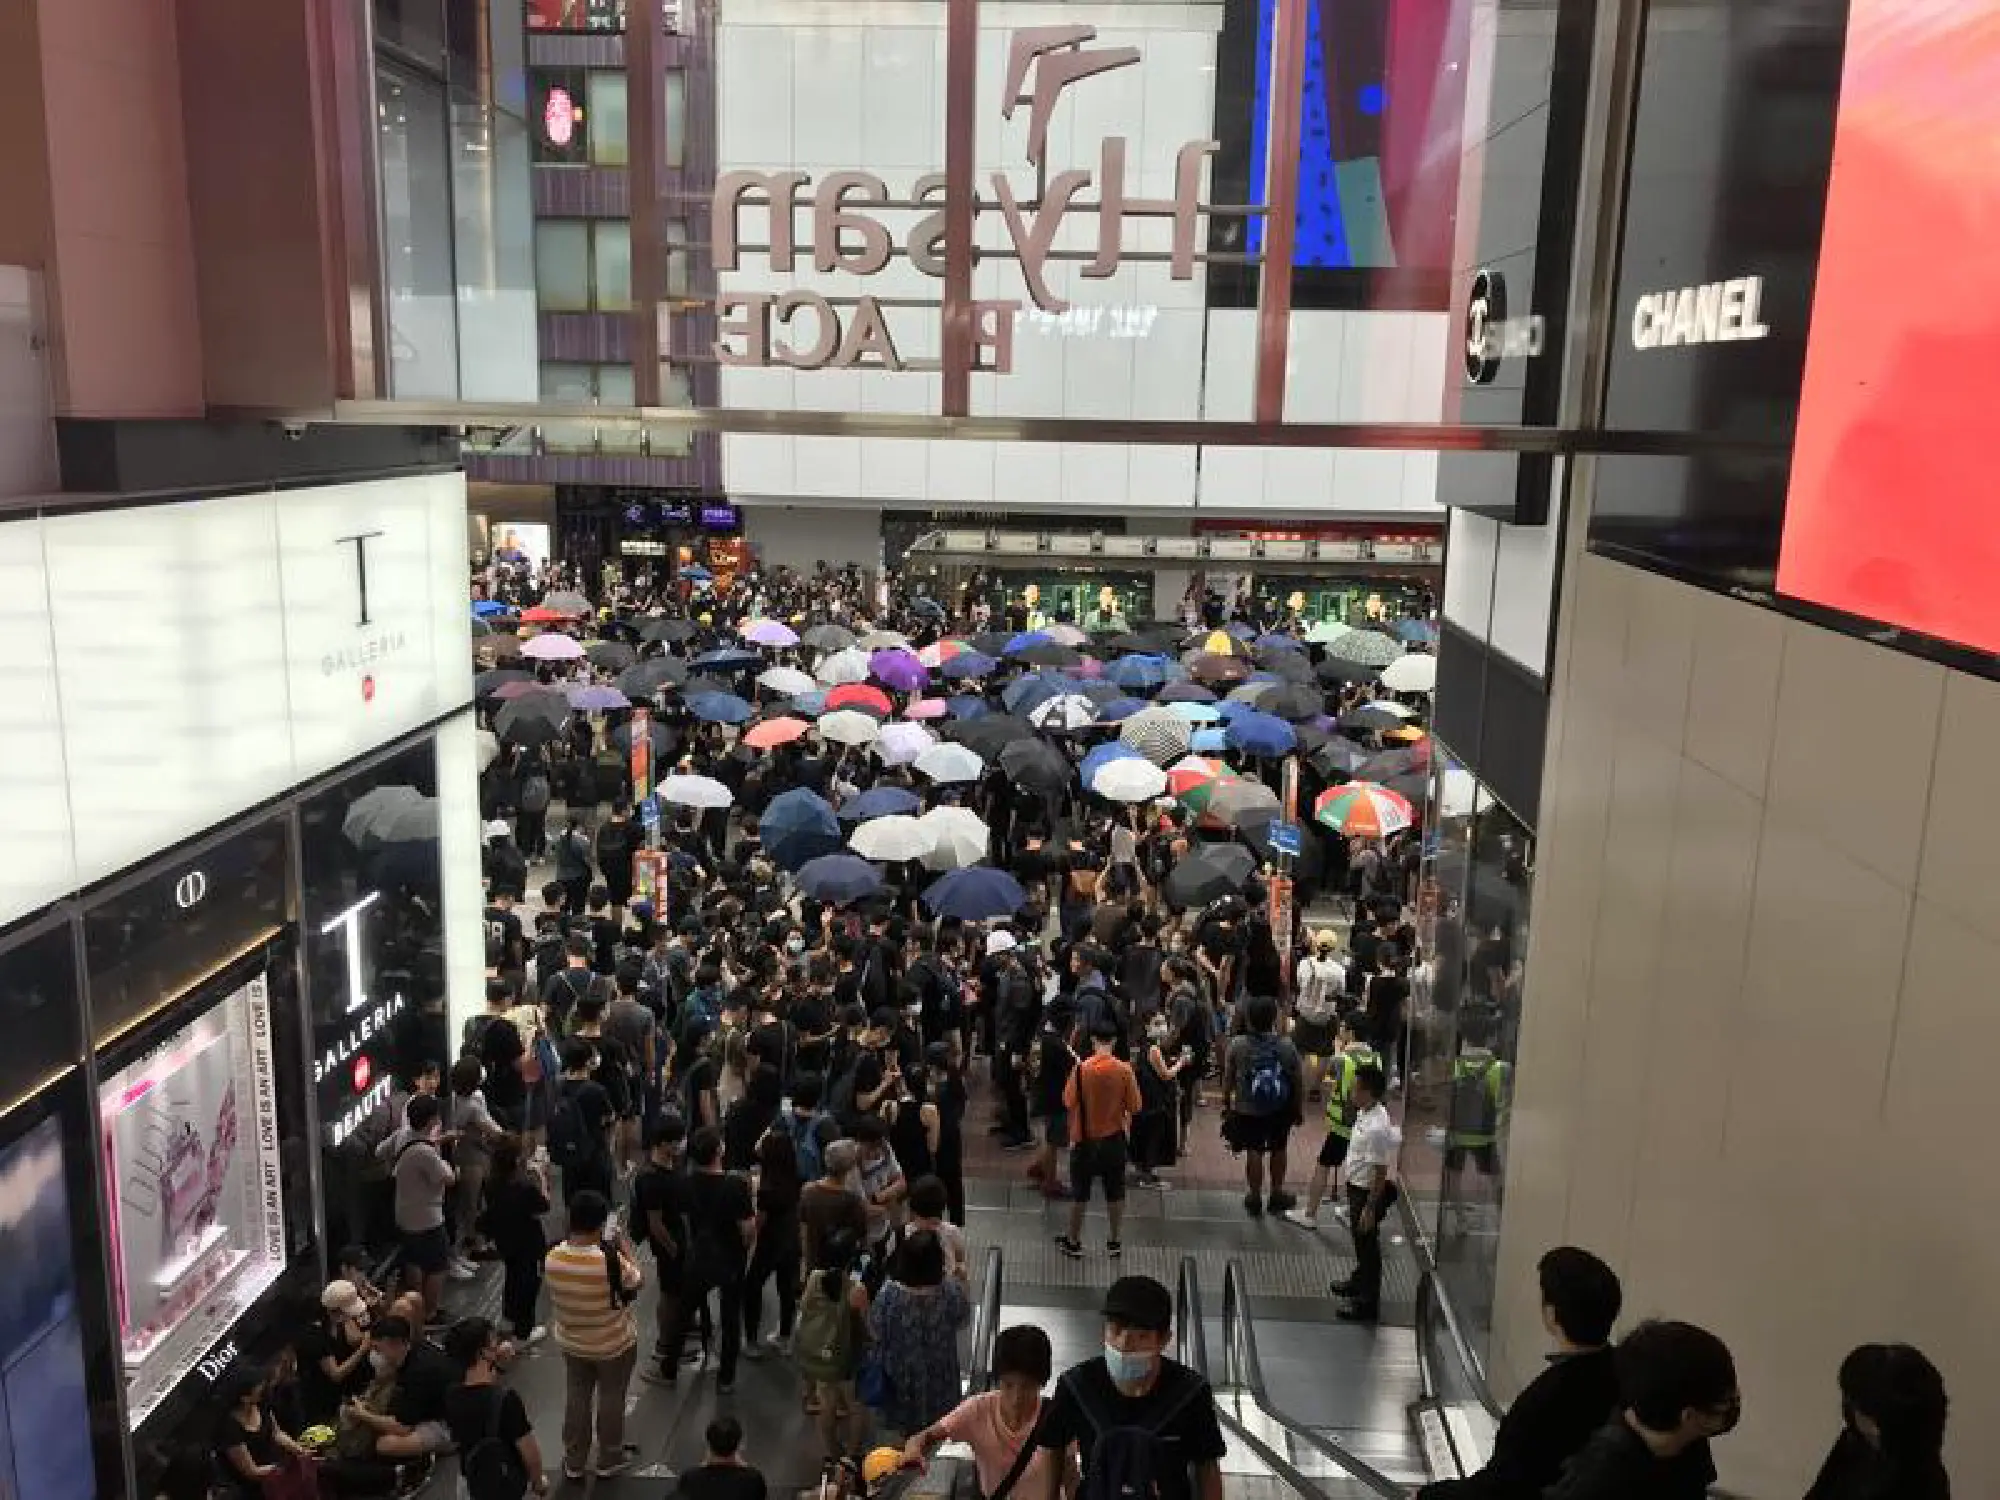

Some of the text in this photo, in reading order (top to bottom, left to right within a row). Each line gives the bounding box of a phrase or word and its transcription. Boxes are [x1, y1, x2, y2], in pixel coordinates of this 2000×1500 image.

[1632, 276, 1770, 351] CHANEL
[333, 530, 384, 627] T
[321, 890, 381, 1014] T
[261, 1116, 274, 1150] LOVE
[264, 1160, 276, 1188] ART
[197, 1341, 238, 1381] Dior
